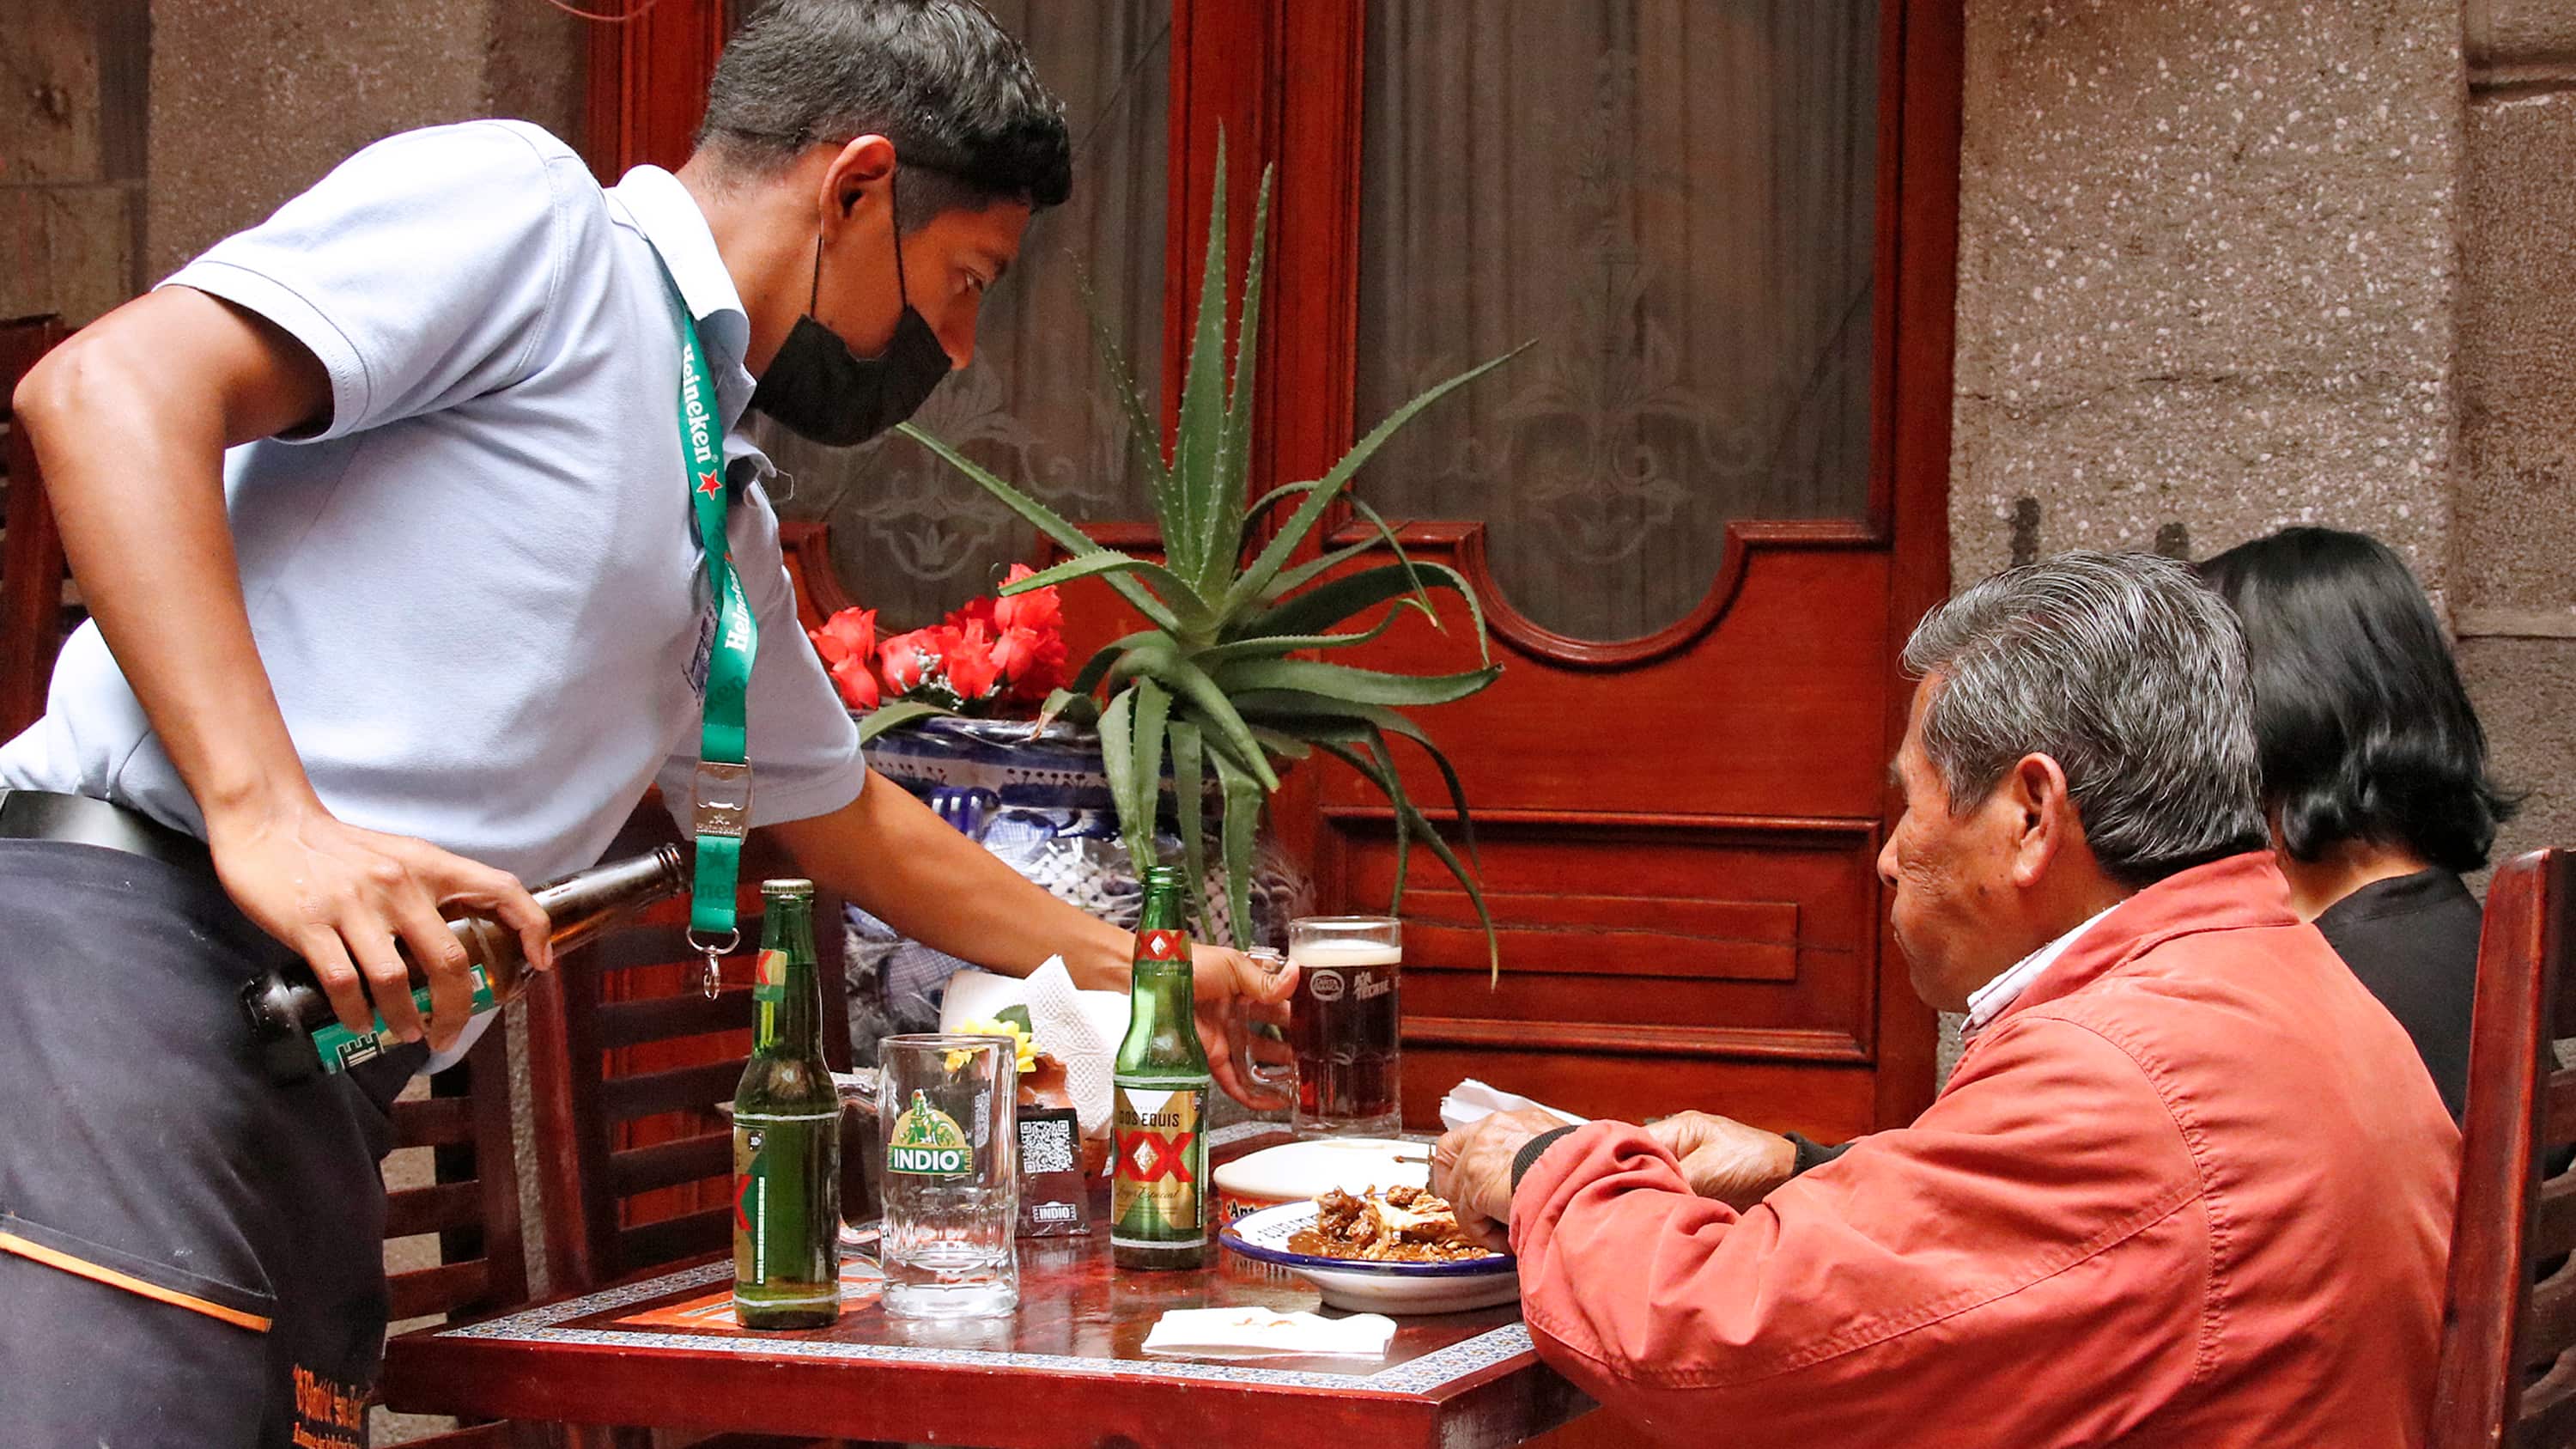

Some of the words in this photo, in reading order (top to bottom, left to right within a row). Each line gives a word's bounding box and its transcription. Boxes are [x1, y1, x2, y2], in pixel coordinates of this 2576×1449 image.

[1141, 1112, 1180, 1127] EQUIS
[894, 1148, 959, 1170] INDIO
[1039, 1207, 1070, 1220] INDIO
